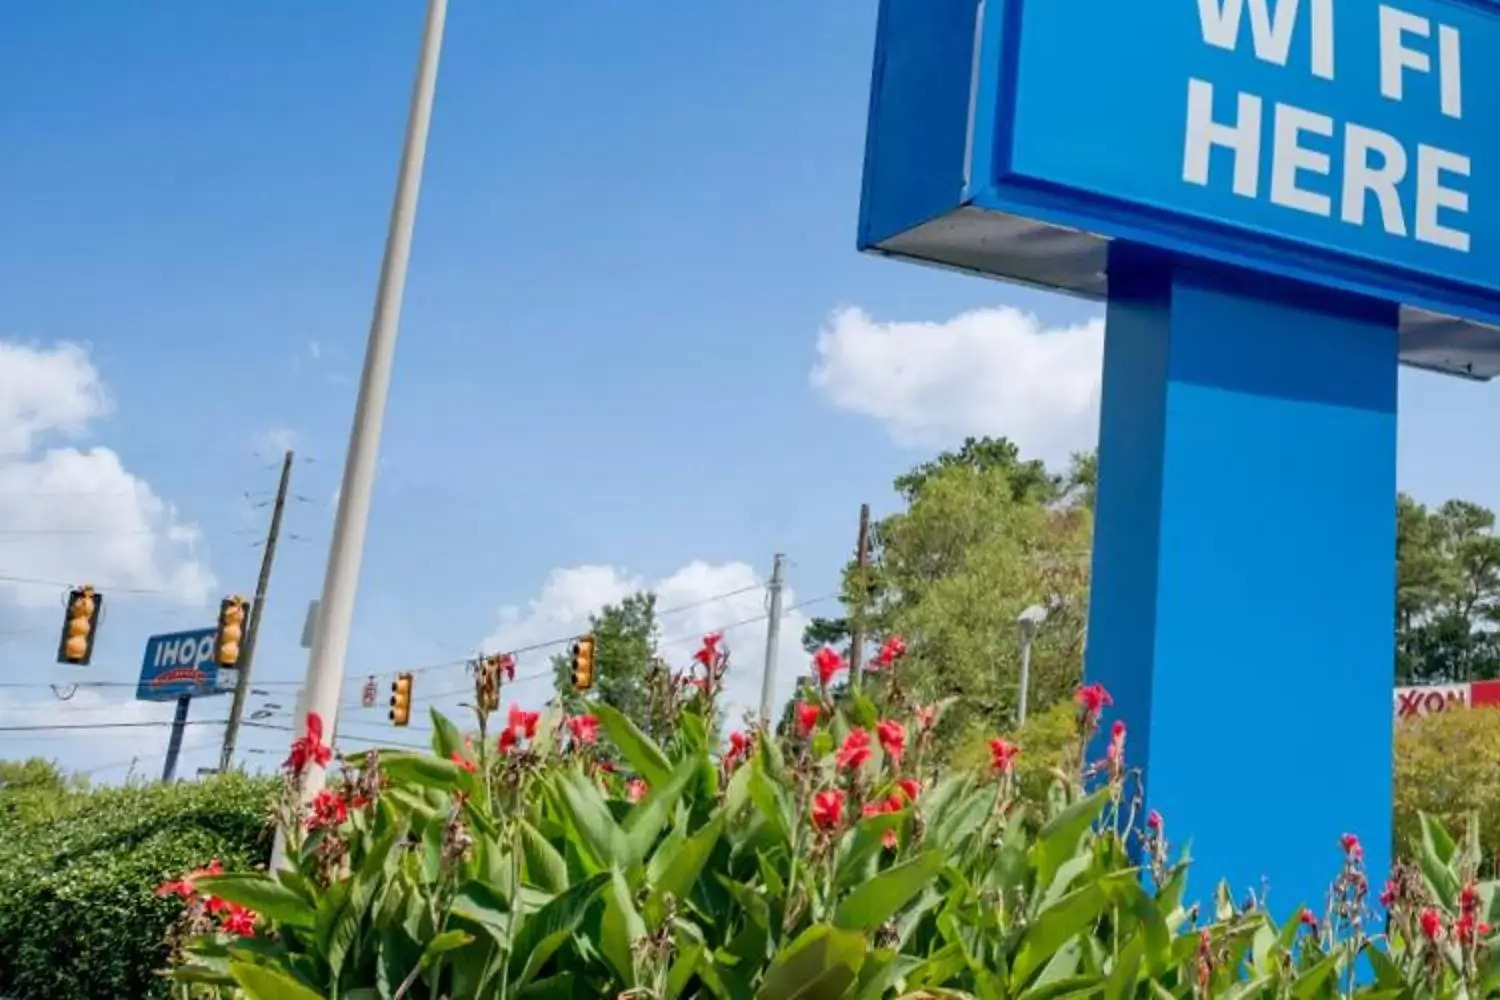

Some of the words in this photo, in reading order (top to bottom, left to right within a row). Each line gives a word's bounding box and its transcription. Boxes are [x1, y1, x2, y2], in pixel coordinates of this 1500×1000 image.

[1379, 5, 1462, 118] FI
[1182, 79, 1471, 252] HERE
[1397, 689, 1465, 717] XXON
